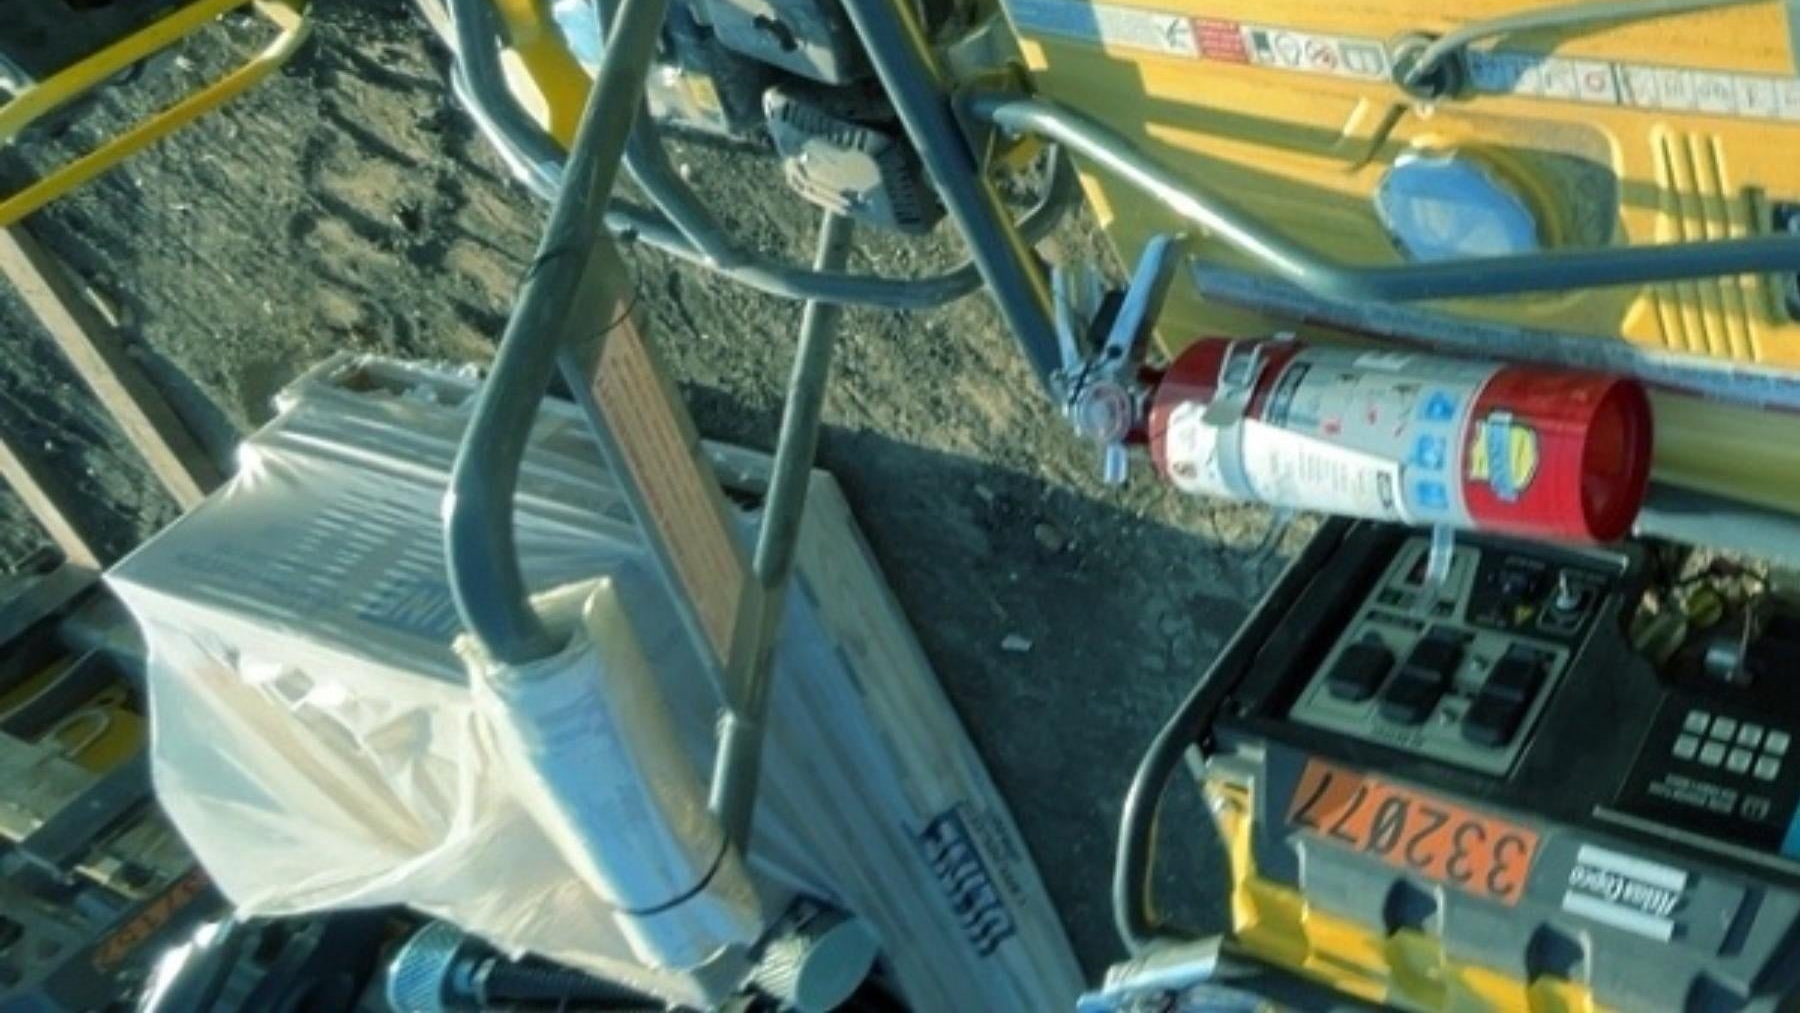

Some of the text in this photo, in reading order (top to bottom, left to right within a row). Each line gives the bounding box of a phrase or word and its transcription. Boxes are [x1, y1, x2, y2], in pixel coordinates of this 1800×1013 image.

[1290, 771, 1527, 896] 332077
[1568, 865, 1680, 917] Atlas Copco
